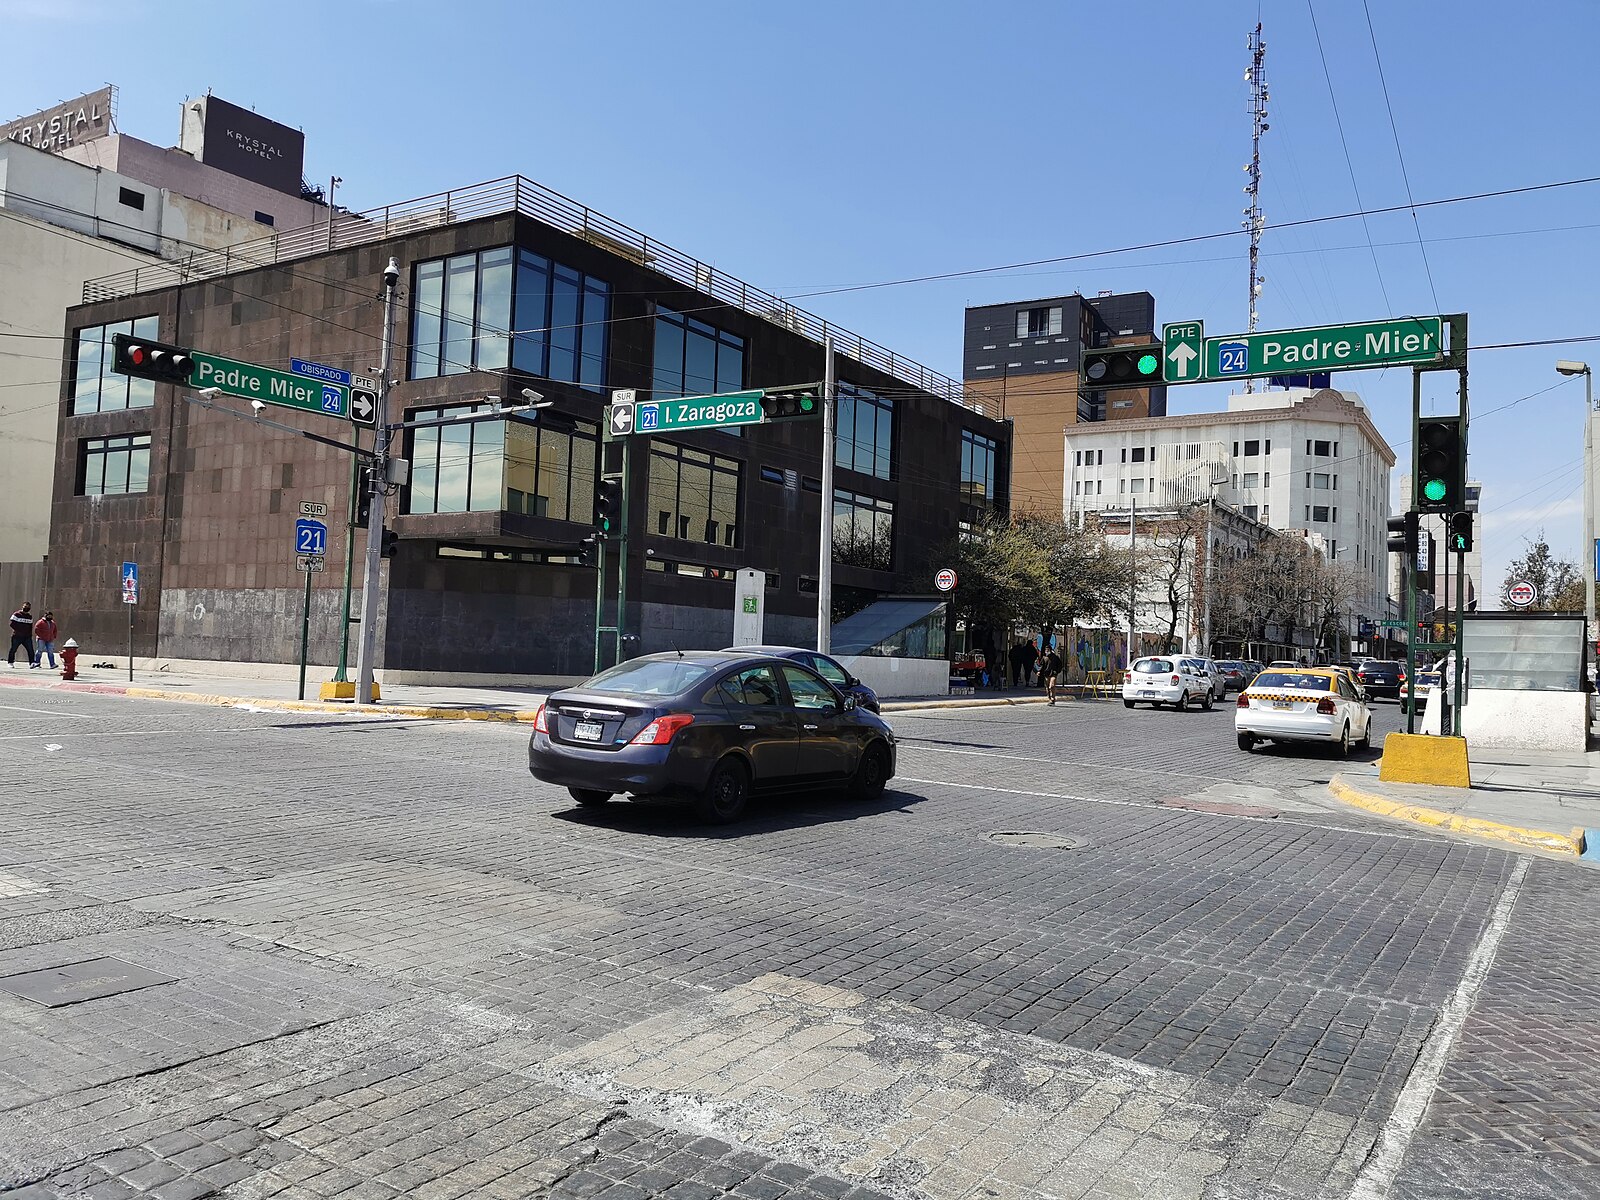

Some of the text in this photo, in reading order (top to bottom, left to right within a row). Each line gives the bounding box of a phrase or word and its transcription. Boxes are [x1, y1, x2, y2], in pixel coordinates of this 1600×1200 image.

[226, 129, 283, 157] KRYSTAL
[238, 143, 272, 160] HOTEL
[1170, 327, 1195, 339] PTE
[1222, 331, 1434, 371] 24 Padre Mier
[301, 364, 342, 381] OBISPADO
[199, 361, 339, 411] Padre Mier 24
[355, 377, 372, 388] PTE
[616, 392, 632, 401] SUR
[643, 414, 657, 427] 21
[678, 401, 755, 422] Zaragoza
[304, 504, 323, 513] SUR
[300, 529, 321, 551] 21
